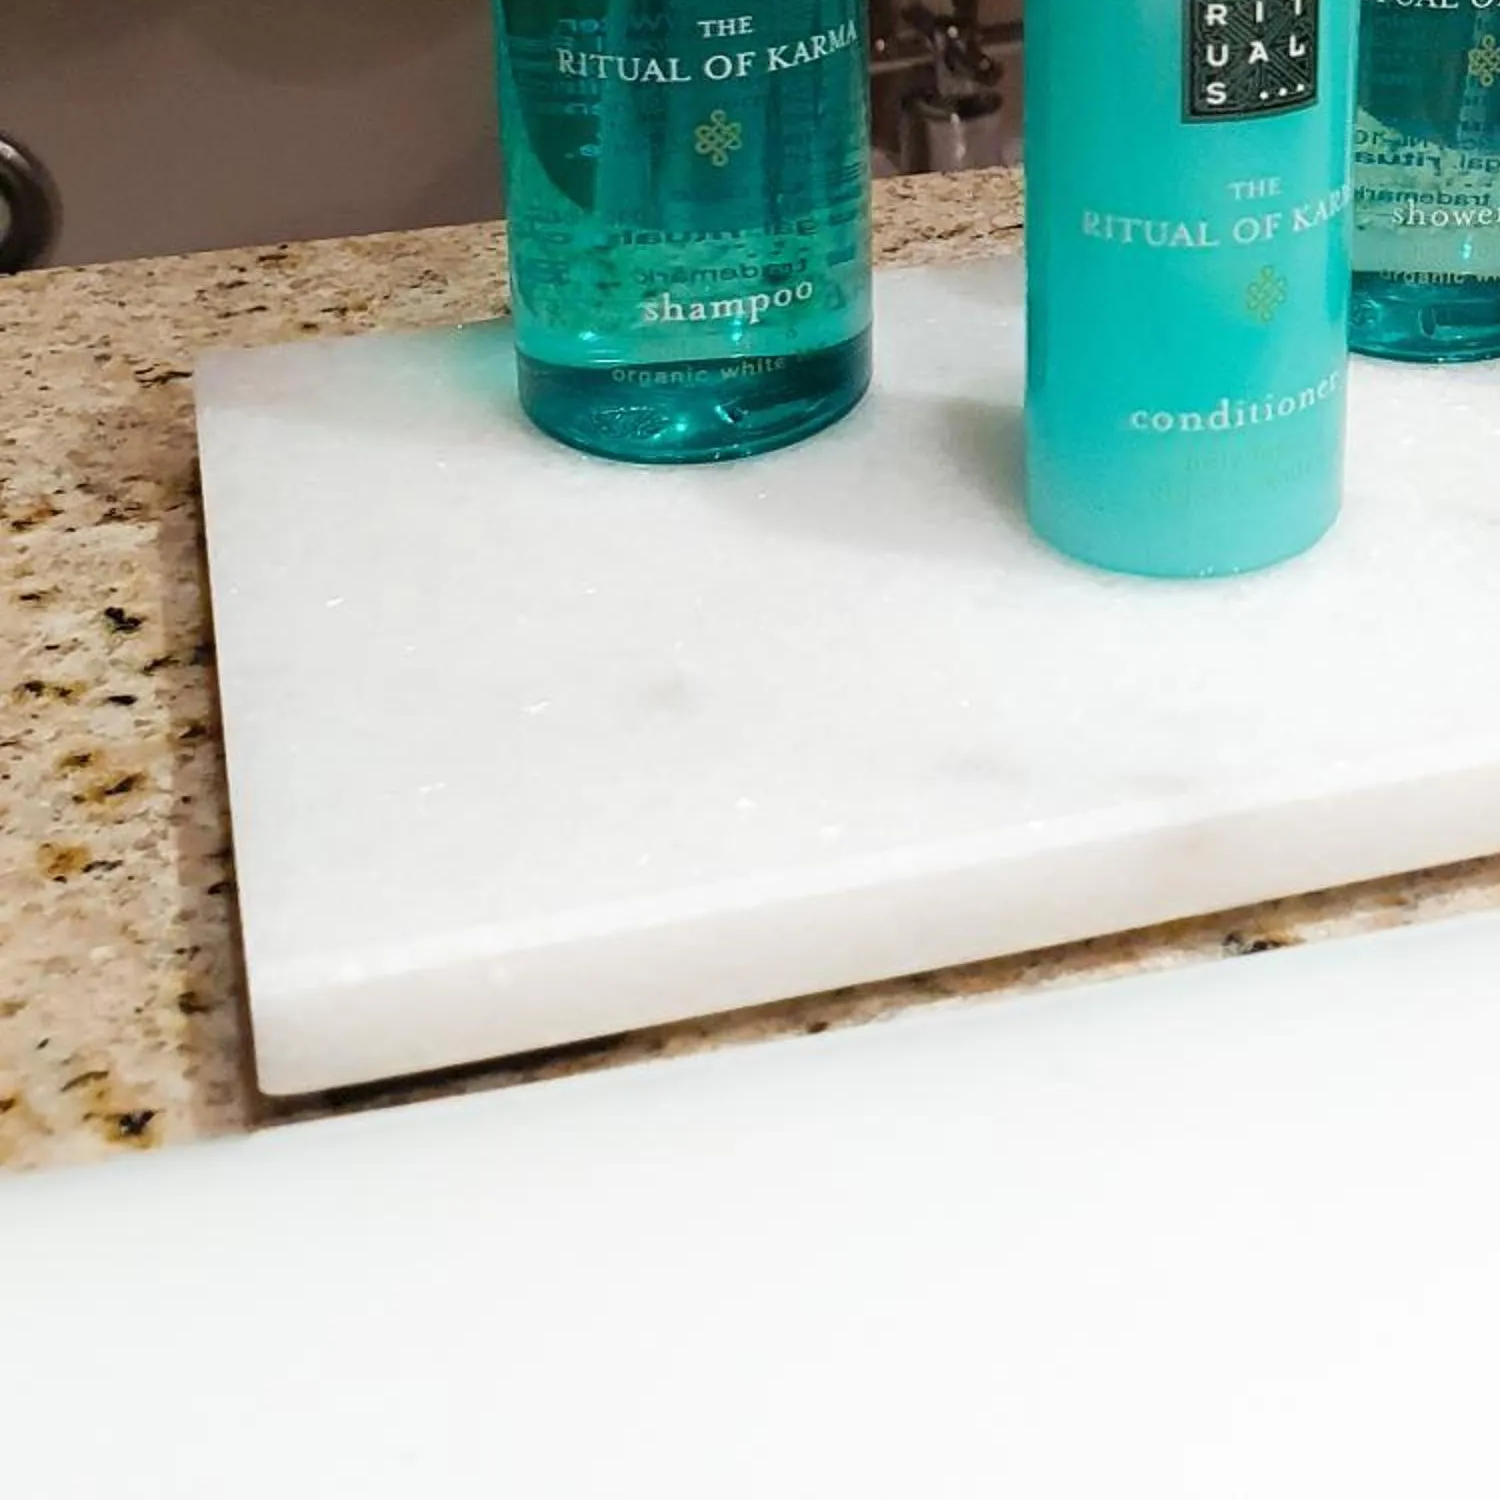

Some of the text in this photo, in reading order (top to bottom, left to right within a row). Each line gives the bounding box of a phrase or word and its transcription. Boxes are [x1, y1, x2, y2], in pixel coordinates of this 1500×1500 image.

[697, 16, 753, 38] THE
[557, 19, 858, 83] RITUAL OF KARMA
[1227, 176, 1283, 201] THE
[1081, 208, 1220, 248] RITUAL
[1233, 212, 1283, 244] OF
[643, 281, 813, 324] shampoo
[1129, 370, 1340, 432] conditioner
